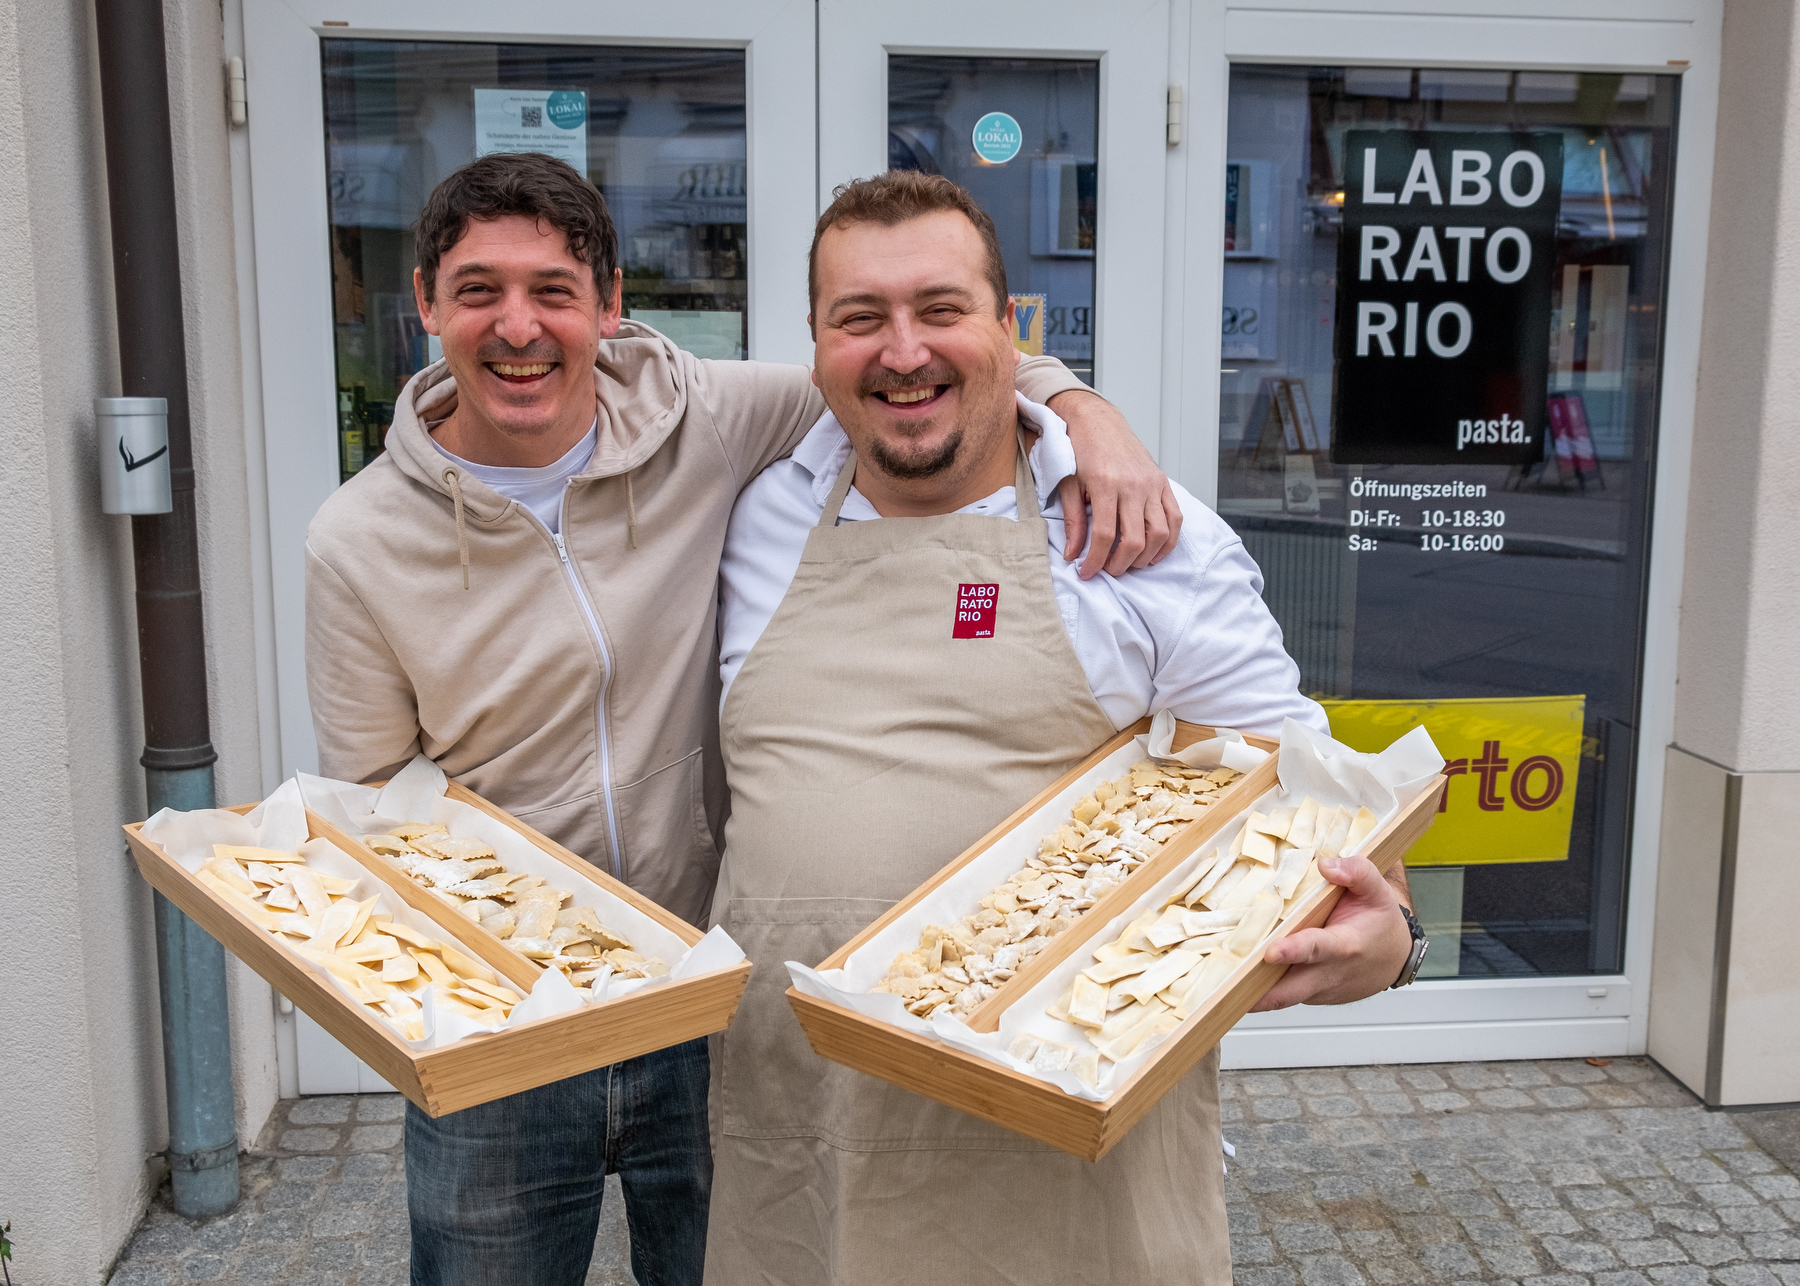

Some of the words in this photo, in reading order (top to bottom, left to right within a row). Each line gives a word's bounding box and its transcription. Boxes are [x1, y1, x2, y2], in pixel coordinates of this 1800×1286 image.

[549, 102, 586, 115] LOKAL
[978, 131, 1017, 143] LOKAL
[1362, 147, 1546, 208] LABO
[1358, 225, 1532, 285] RATO
[1355, 300, 1473, 359] RIO
[1457, 413, 1532, 451] pasta.
[1350, 476, 1488, 501] Öffnungszeiten
[1350, 509, 1401, 528] Di-Fr:
[1421, 509, 1506, 528] 10-18:30
[1349, 534, 1378, 551] Sa:
[1420, 534, 1504, 551] 10-16:00
[961, 586, 996, 597] LABO
[960, 599, 993, 609] RATO
[958, 611, 981, 622] RIO
